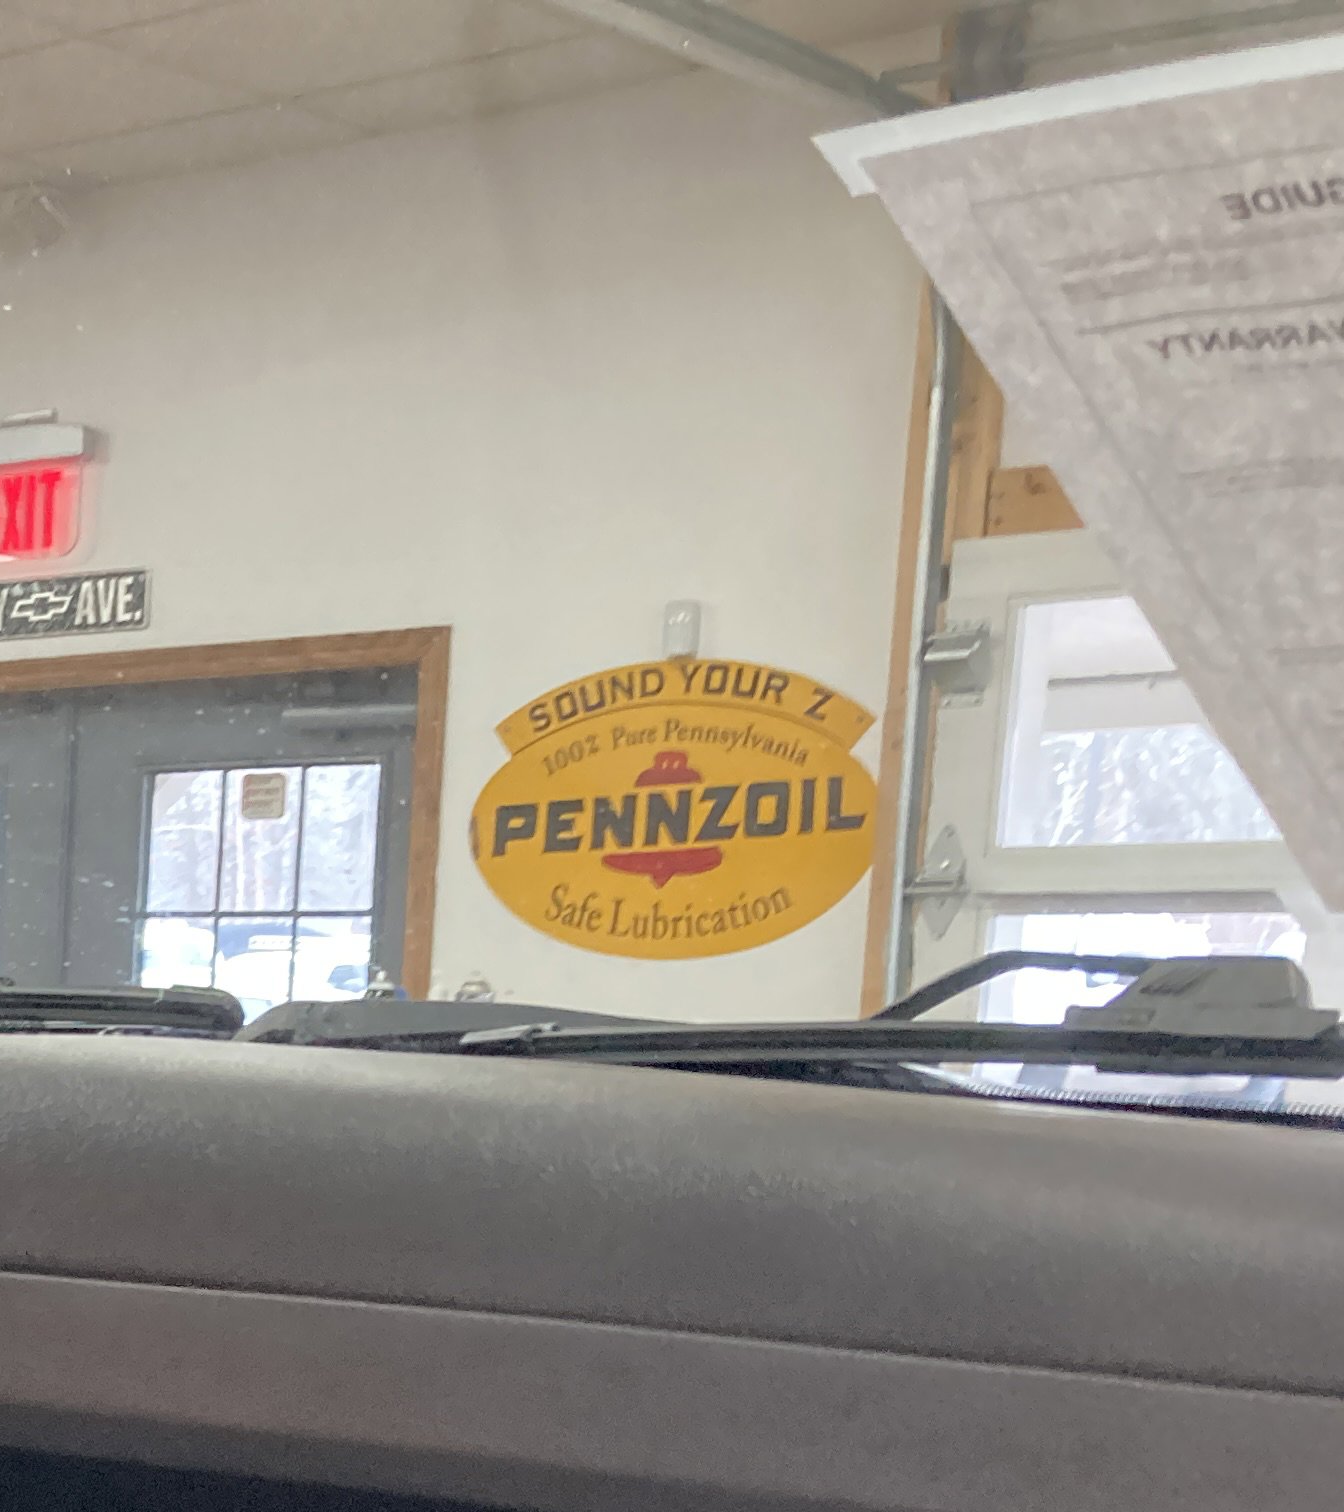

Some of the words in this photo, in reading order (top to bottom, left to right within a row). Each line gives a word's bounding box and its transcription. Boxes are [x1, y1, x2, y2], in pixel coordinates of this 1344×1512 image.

[73, 576, 143, 626] AVE.
[528, 667, 665, 733] SOUND
[678, 663, 791, 704] YOUR
[803, 687, 835, 721] Z
[611, 724, 657, 749] Pure
[663, 718, 810, 767] Pennsylvania
[492, 775, 867, 858] PENNZOIL
[544, 883, 602, 932] Safe
[611, 885, 792, 940] Lubrication
